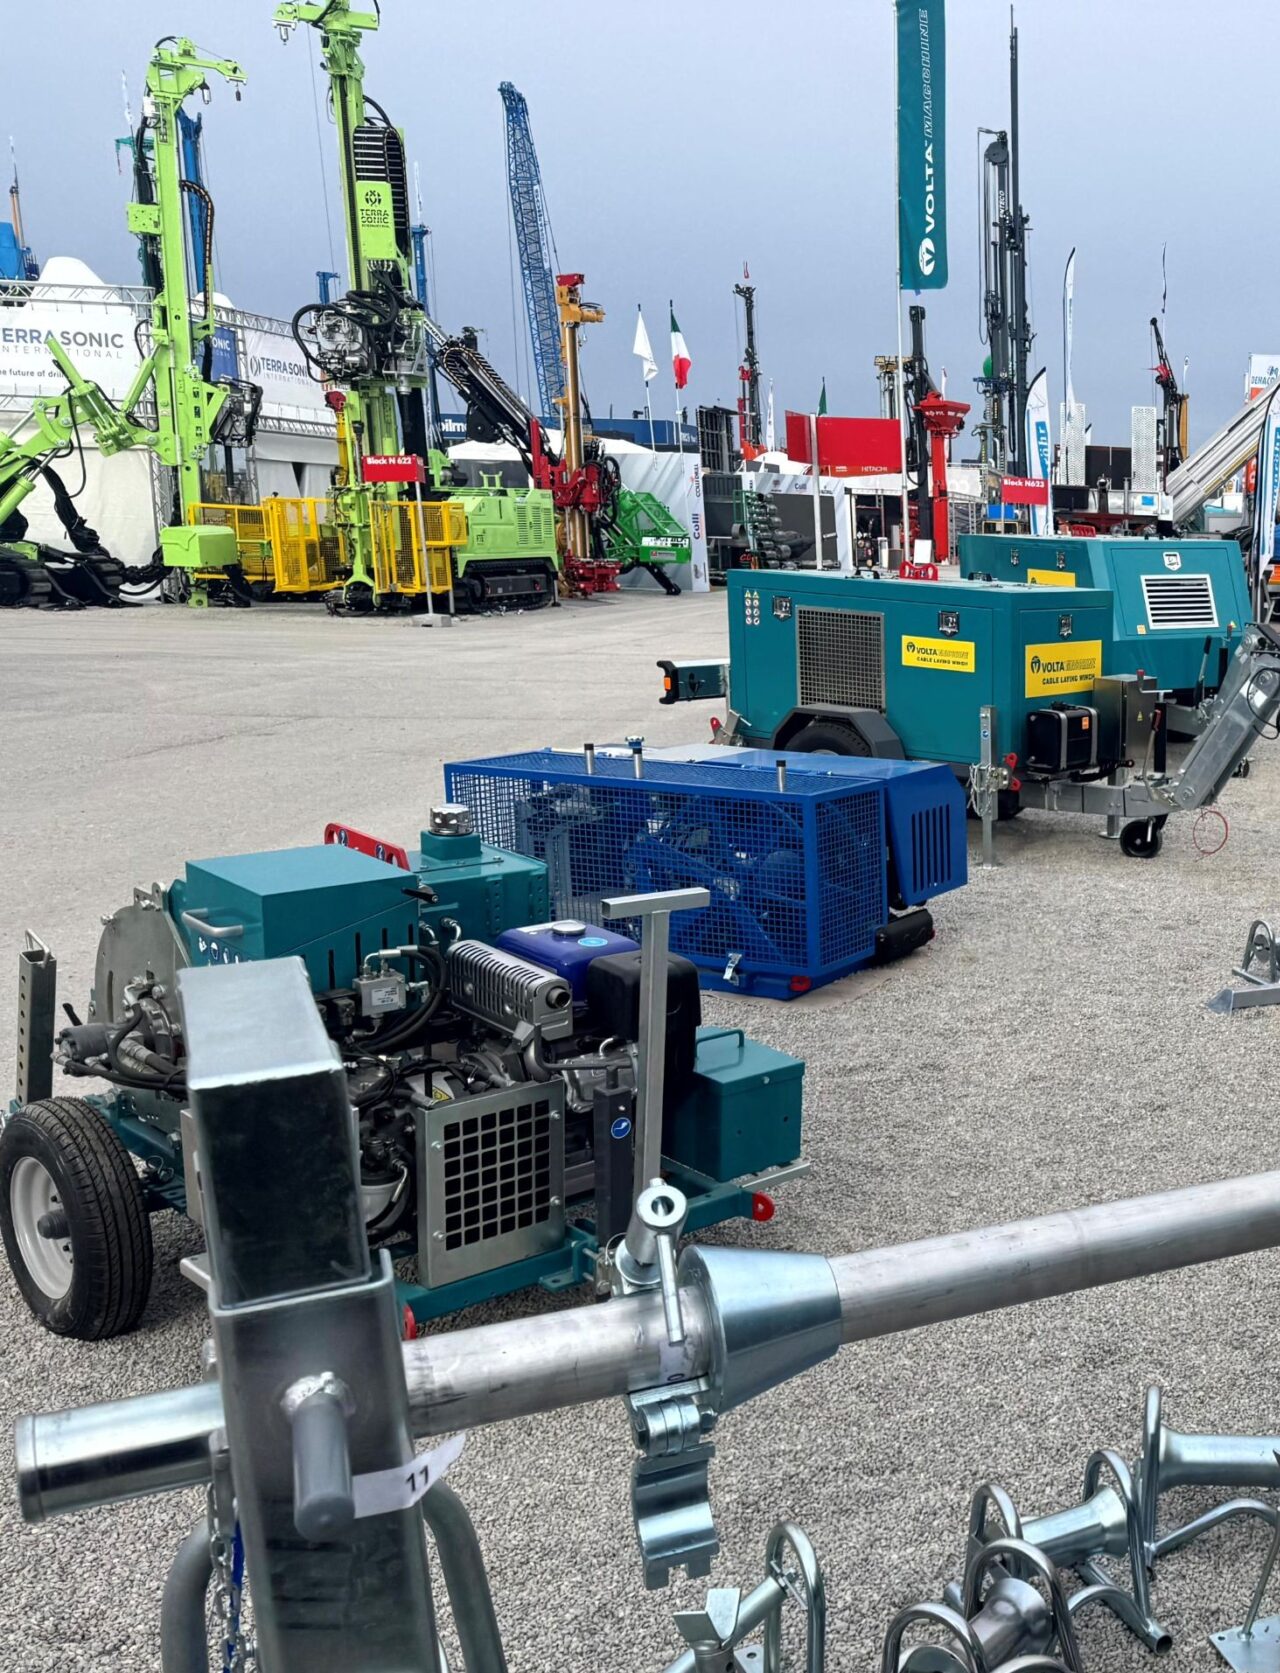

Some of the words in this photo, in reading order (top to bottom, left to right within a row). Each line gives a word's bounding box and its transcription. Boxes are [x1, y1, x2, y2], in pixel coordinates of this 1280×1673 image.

[918, 8, 933, 138] MACCHINE
[924, 143, 936, 234] VOLTA
[9, 368, 34, 376] future
[367, 457, 387, 465] Block
[397, 457, 412, 465] 622
[1003, 479, 1024, 487] Block
[692, 512, 701, 540] Colli
[917, 647, 938, 656] VOLTA
[1041, 661, 1065, 673] VOLTA
[1042, 677, 1060, 685] CABLE
[1060, 675, 1079, 684] LAYING
[405, 1465, 429, 1492] 11
